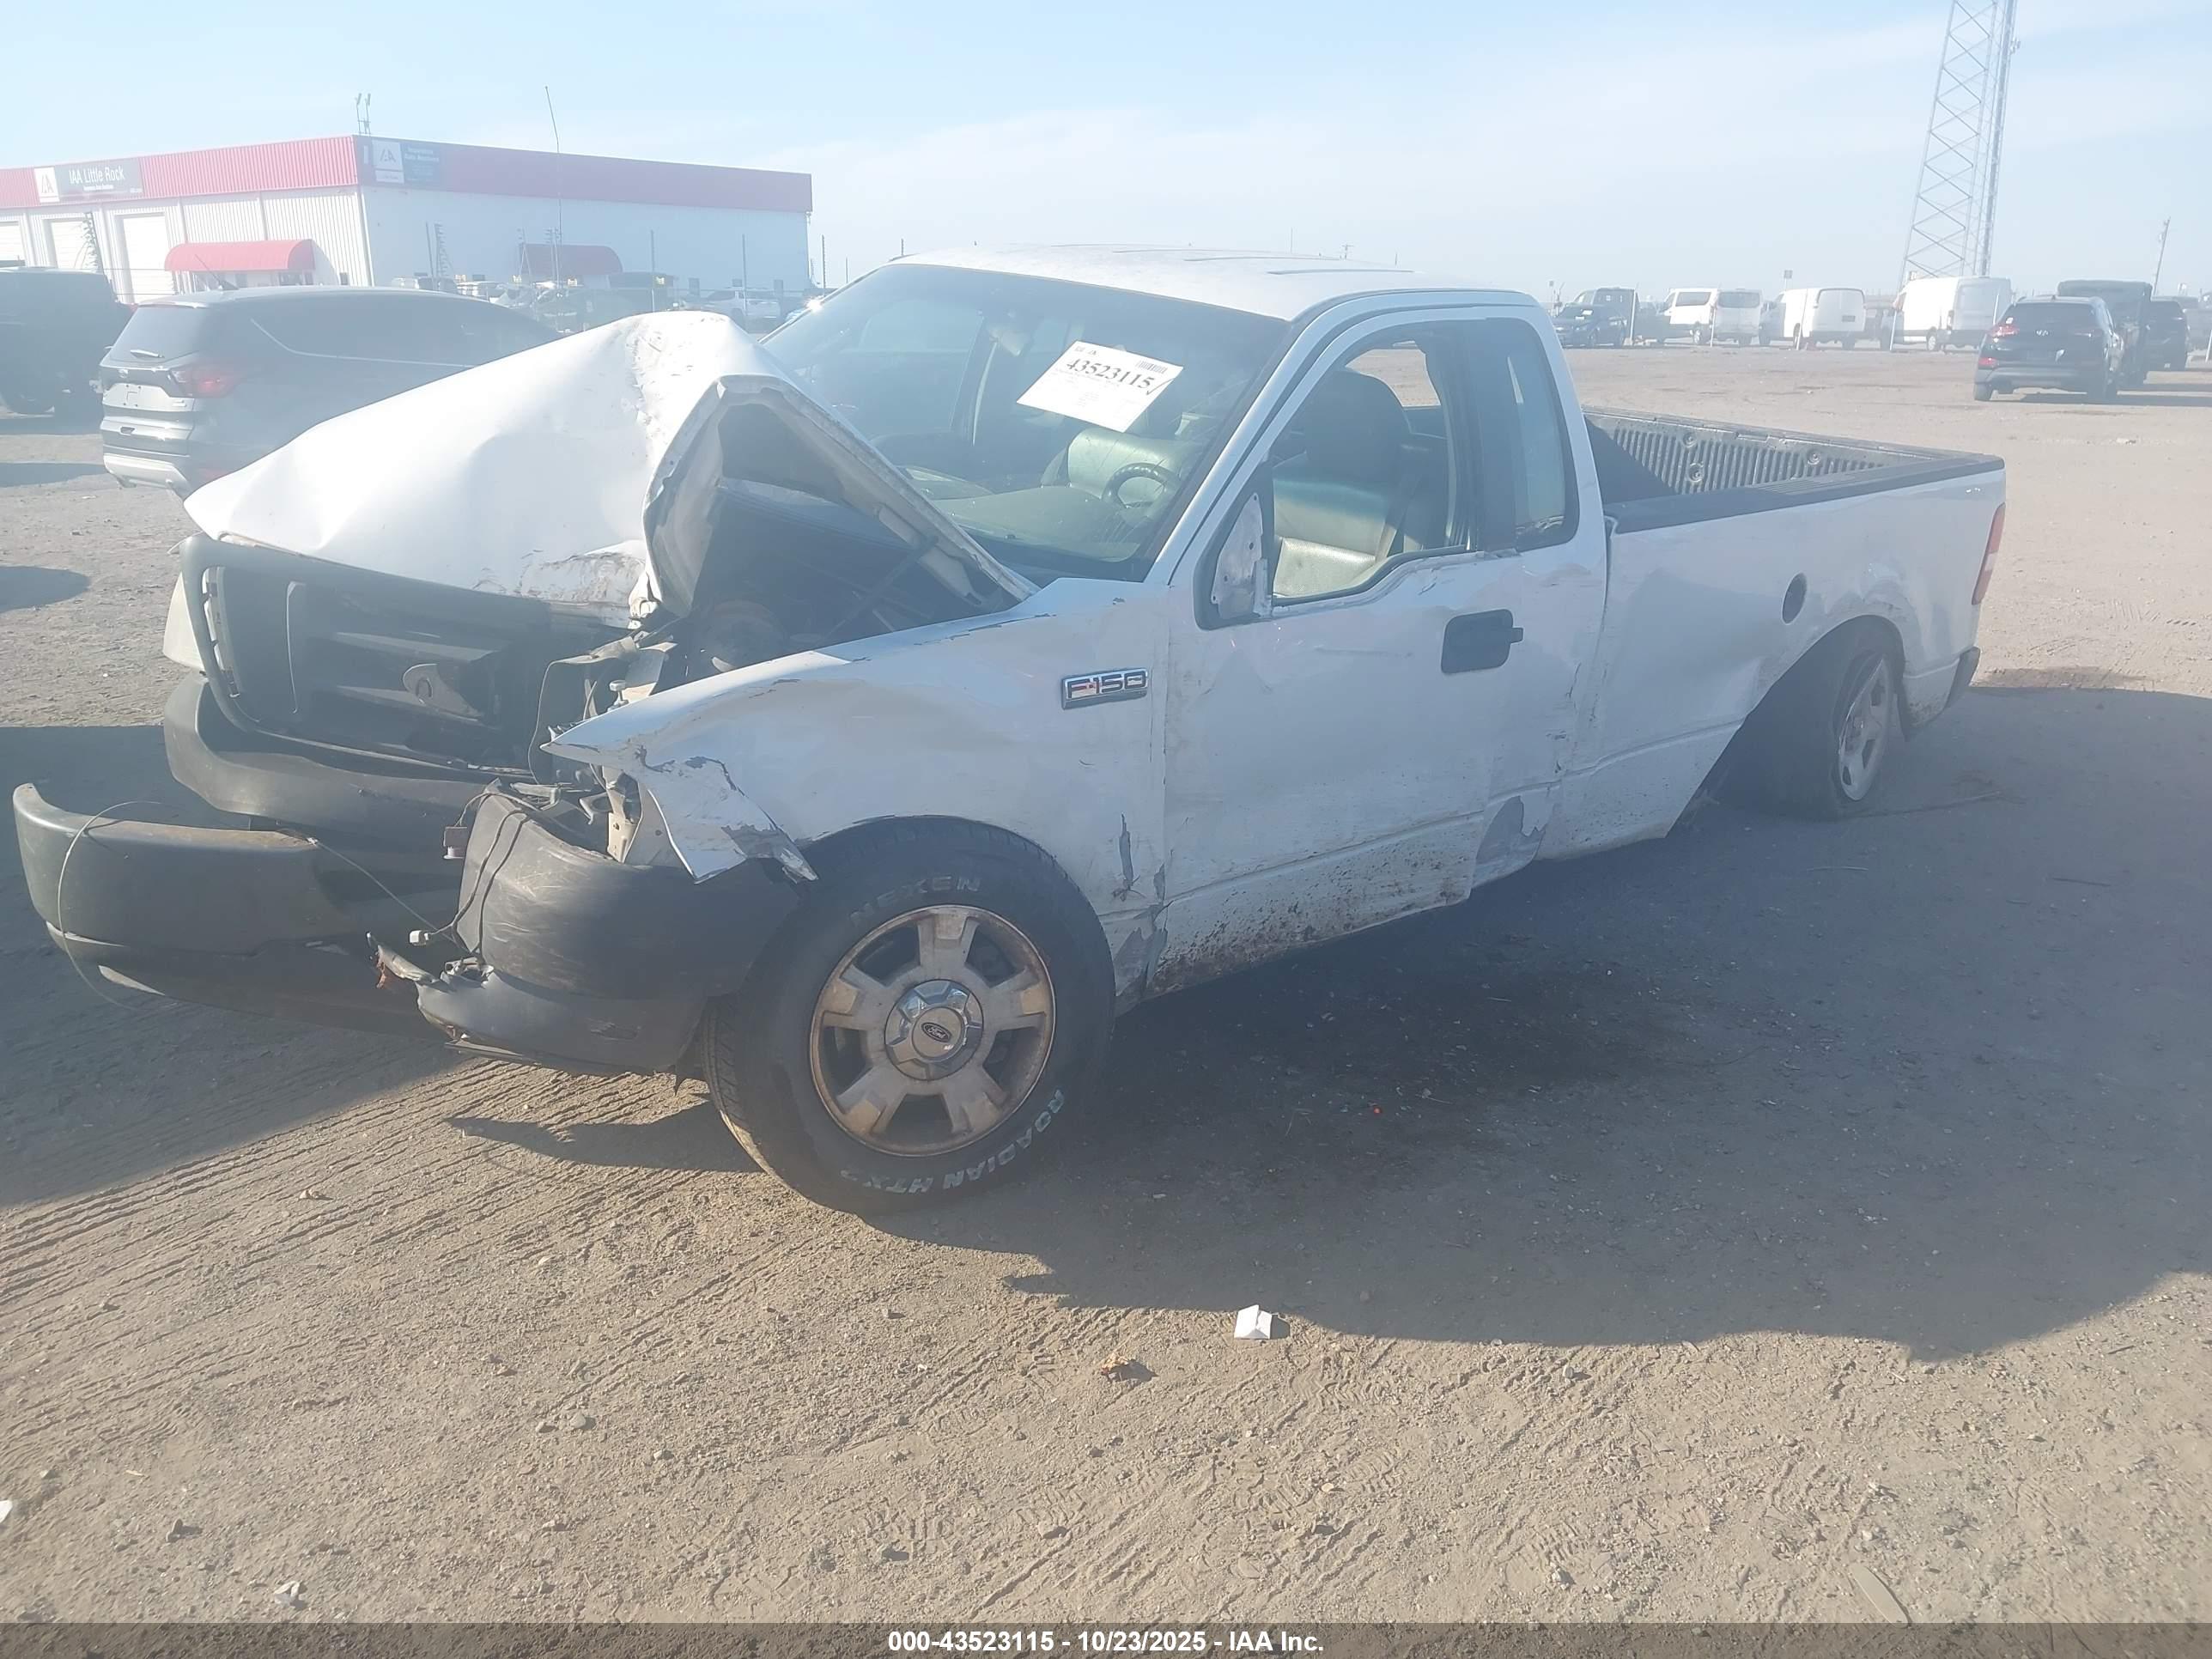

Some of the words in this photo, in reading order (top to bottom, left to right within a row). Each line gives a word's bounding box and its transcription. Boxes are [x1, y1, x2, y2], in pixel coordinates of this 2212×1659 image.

[69, 169, 83, 185] IAA
[83, 167, 104, 183] Little
[105, 164, 125, 182] Rock
[1066, 358, 1156, 388] 43523115
[1065, 669, 1147, 700] F-150
[850, 876, 981, 928] NEXEN
[942, 1088, 1066, 1190] ROADIAN
